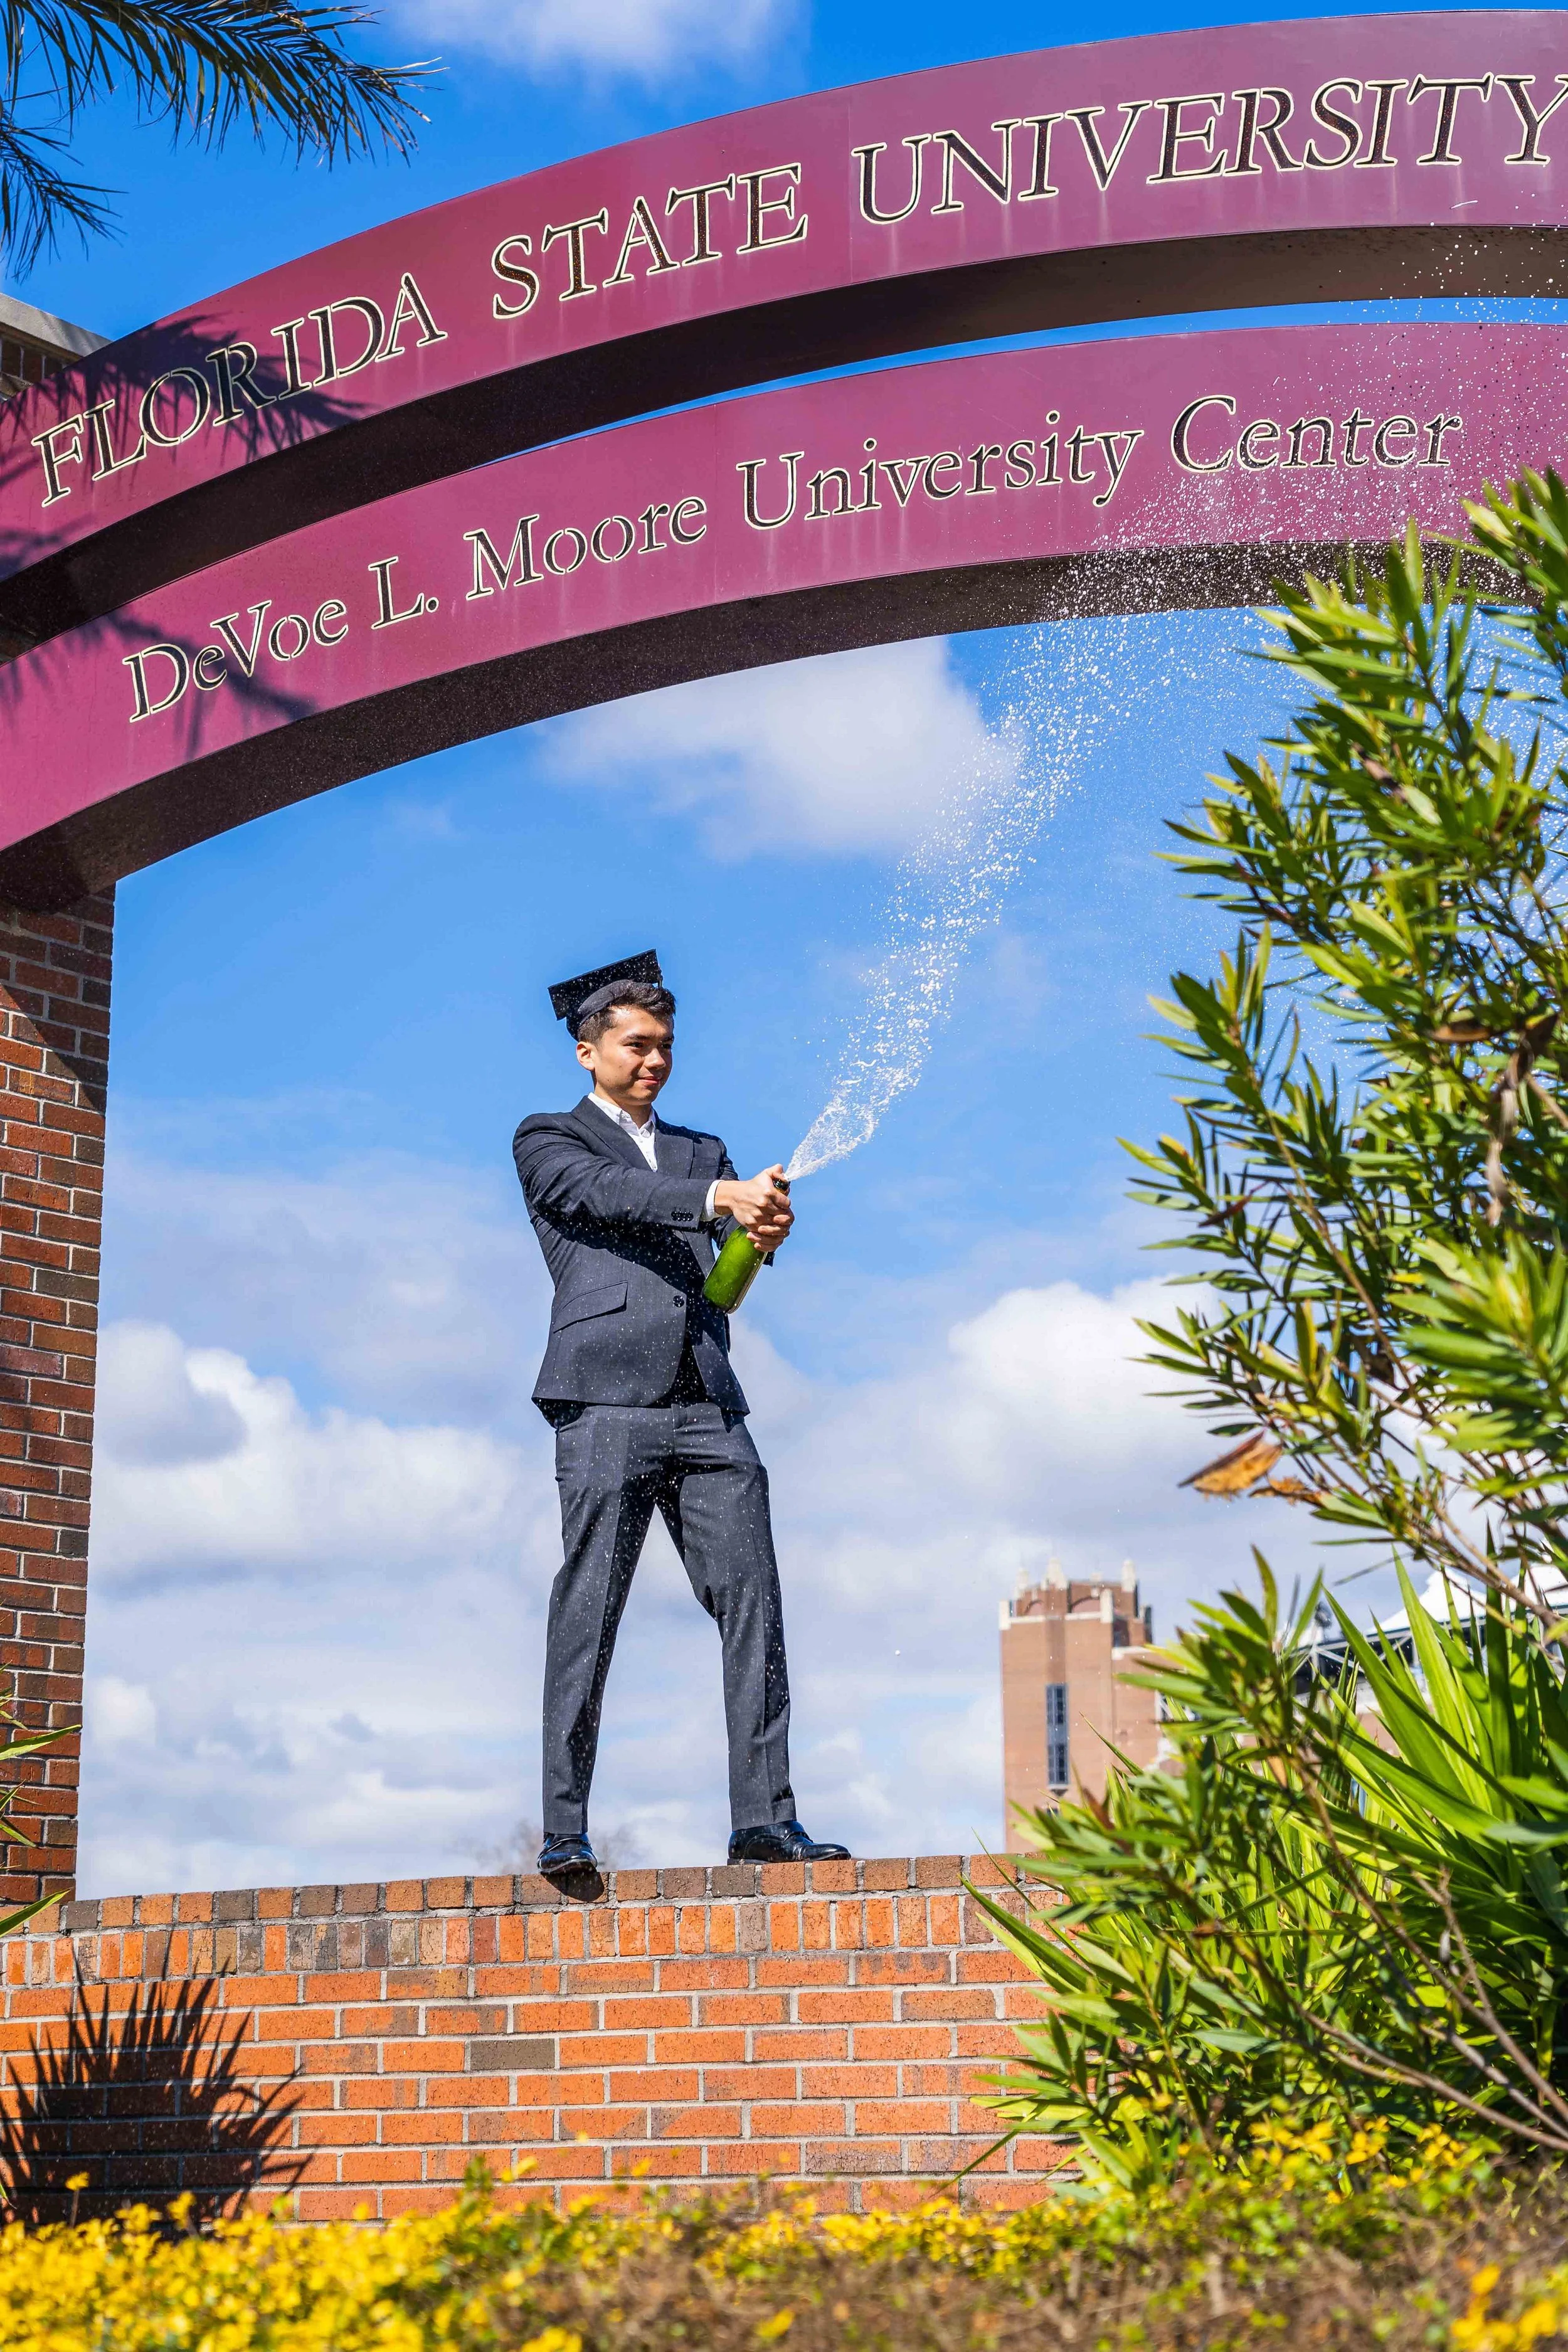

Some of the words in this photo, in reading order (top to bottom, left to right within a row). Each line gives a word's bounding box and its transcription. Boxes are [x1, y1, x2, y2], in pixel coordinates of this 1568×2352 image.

[31, 272, 448, 507] FLORIDA
[491, 162, 808, 319] STATE
[851, 72, 1568, 225] UNIVERSITY
[122, 600, 348, 723] DeVoe
[368, 556, 439, 630] L.
[463, 495, 707, 600] Moore
[736, 409, 1145, 530] University
[1170, 394, 1463, 474] Center
